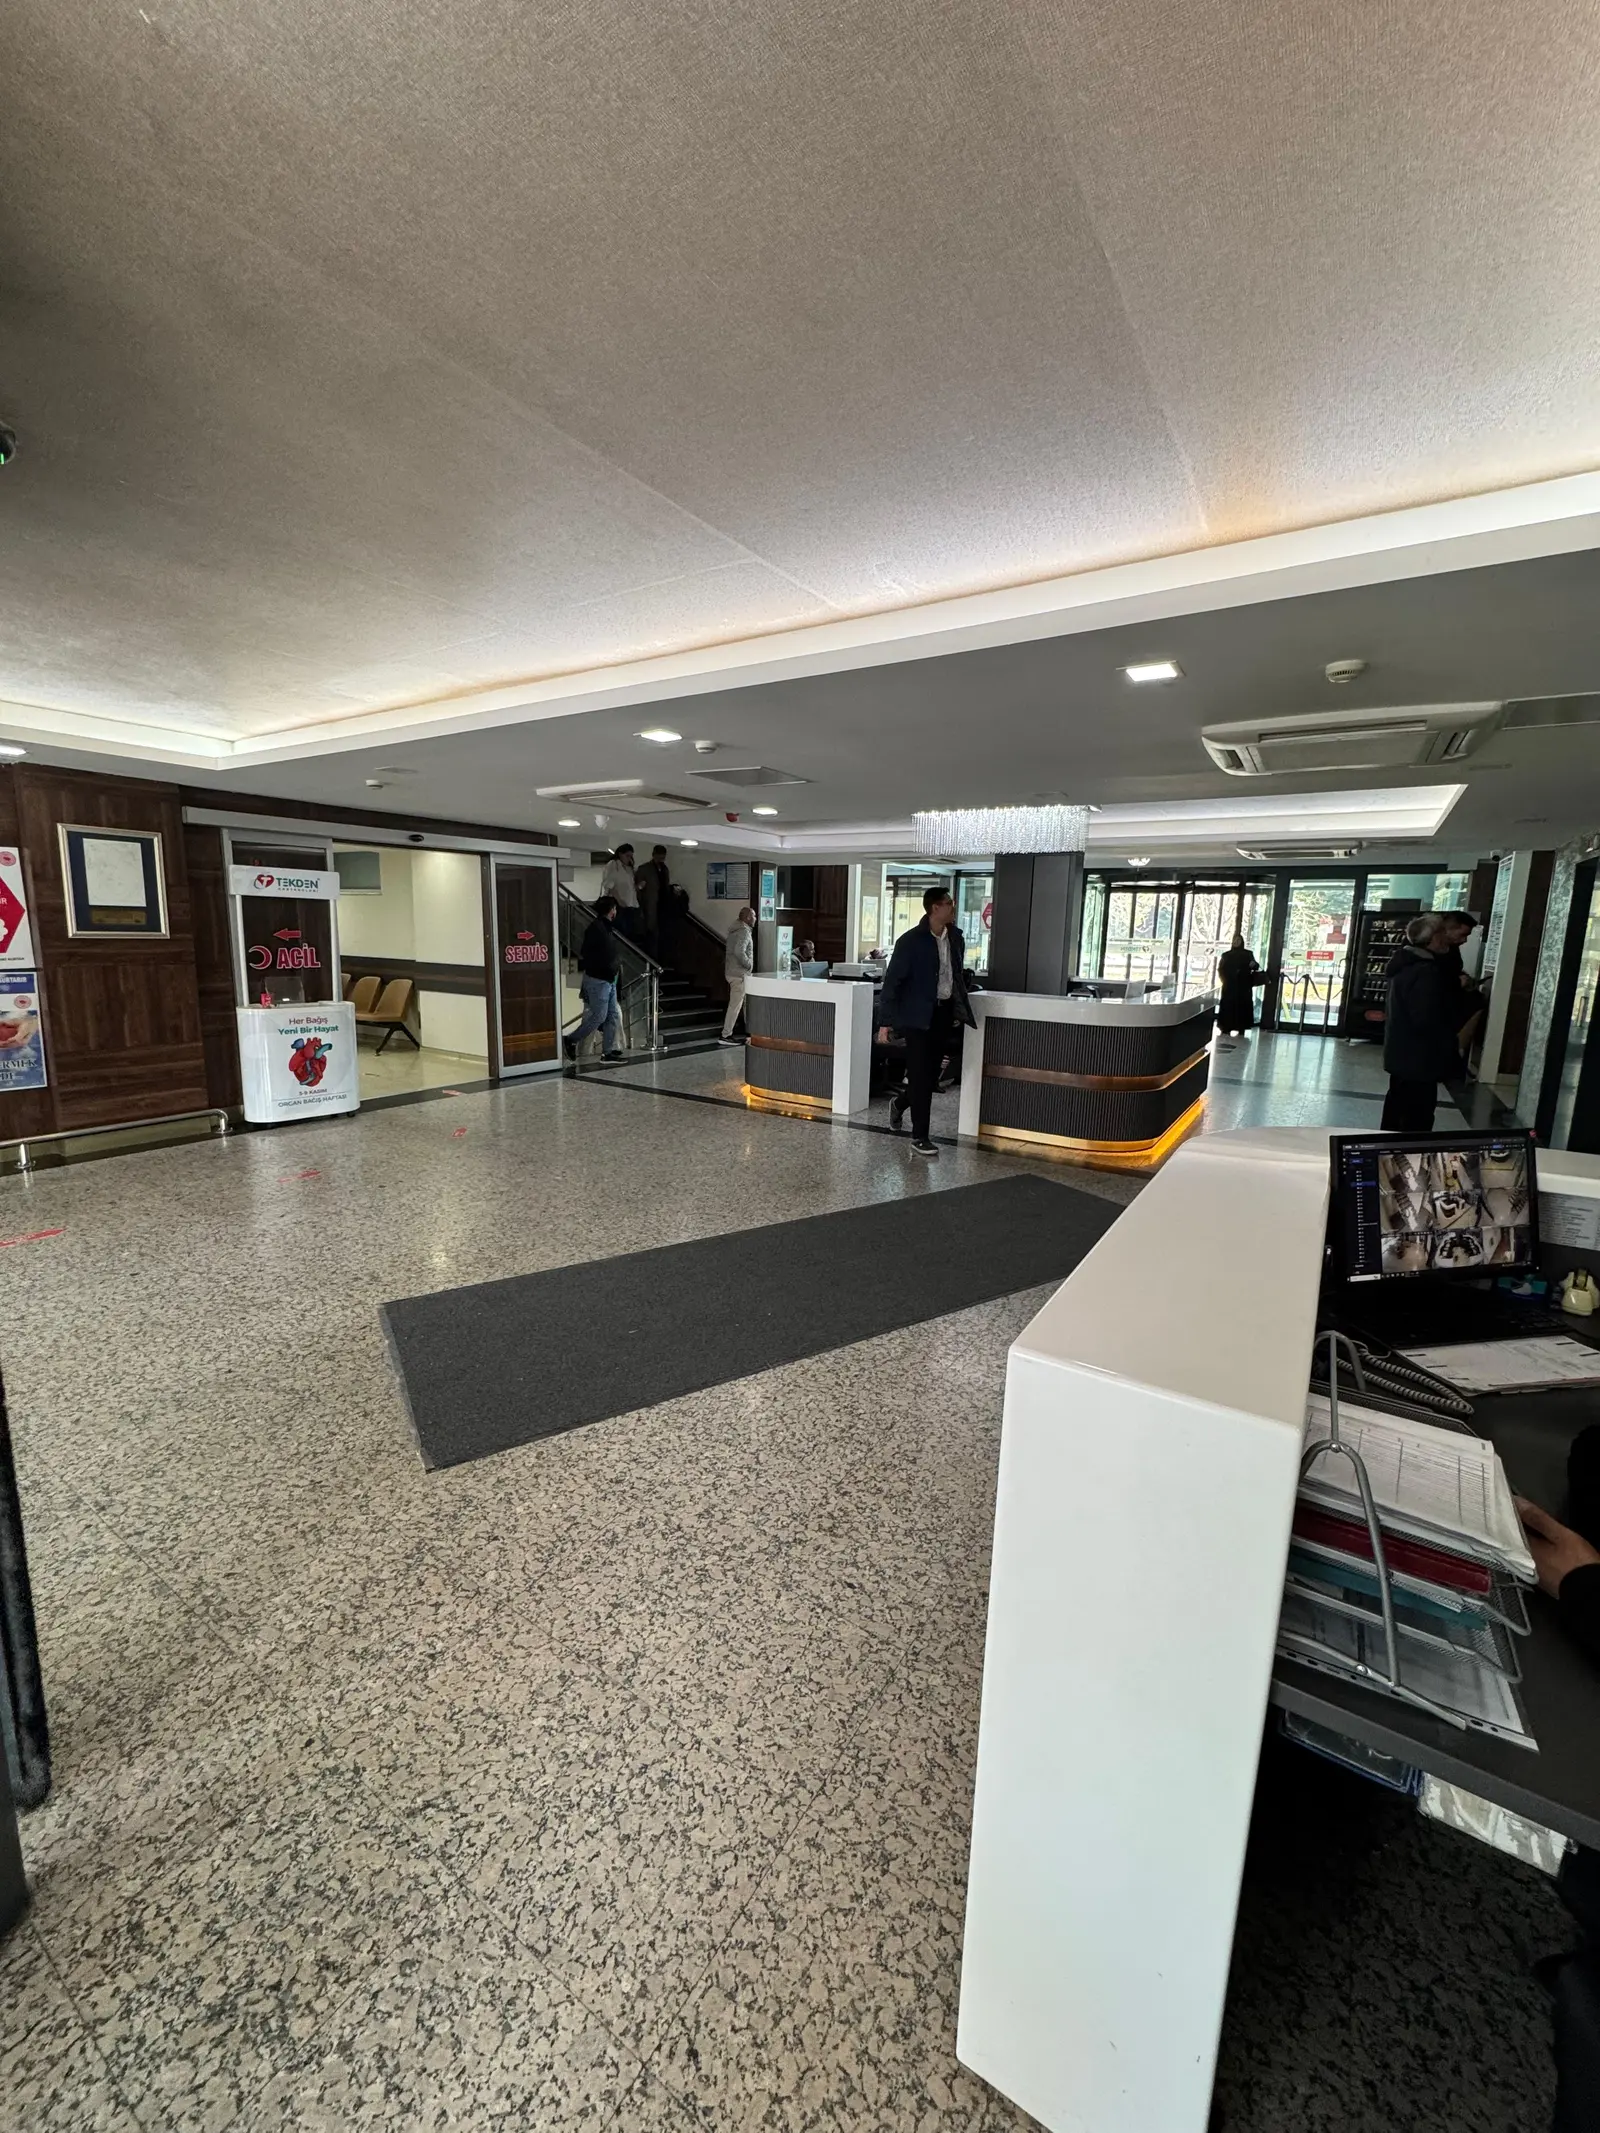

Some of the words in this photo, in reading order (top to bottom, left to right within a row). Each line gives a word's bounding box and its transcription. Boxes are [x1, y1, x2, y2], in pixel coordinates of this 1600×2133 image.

[276, 877, 319, 889] TEKDEN
[276, 942, 321, 970] ACİL
[505, 941, 549, 964] SERVİS
[289, 1017, 304, 1025] Her
[306, 1016, 328, 1025] Bağış
[278, 1027, 298, 1035] Yeni
[300, 1025, 312, 1034] Bir
[314, 1024, 339, 1034] Hayat
[278, 1099, 302, 1108] ORGAN
